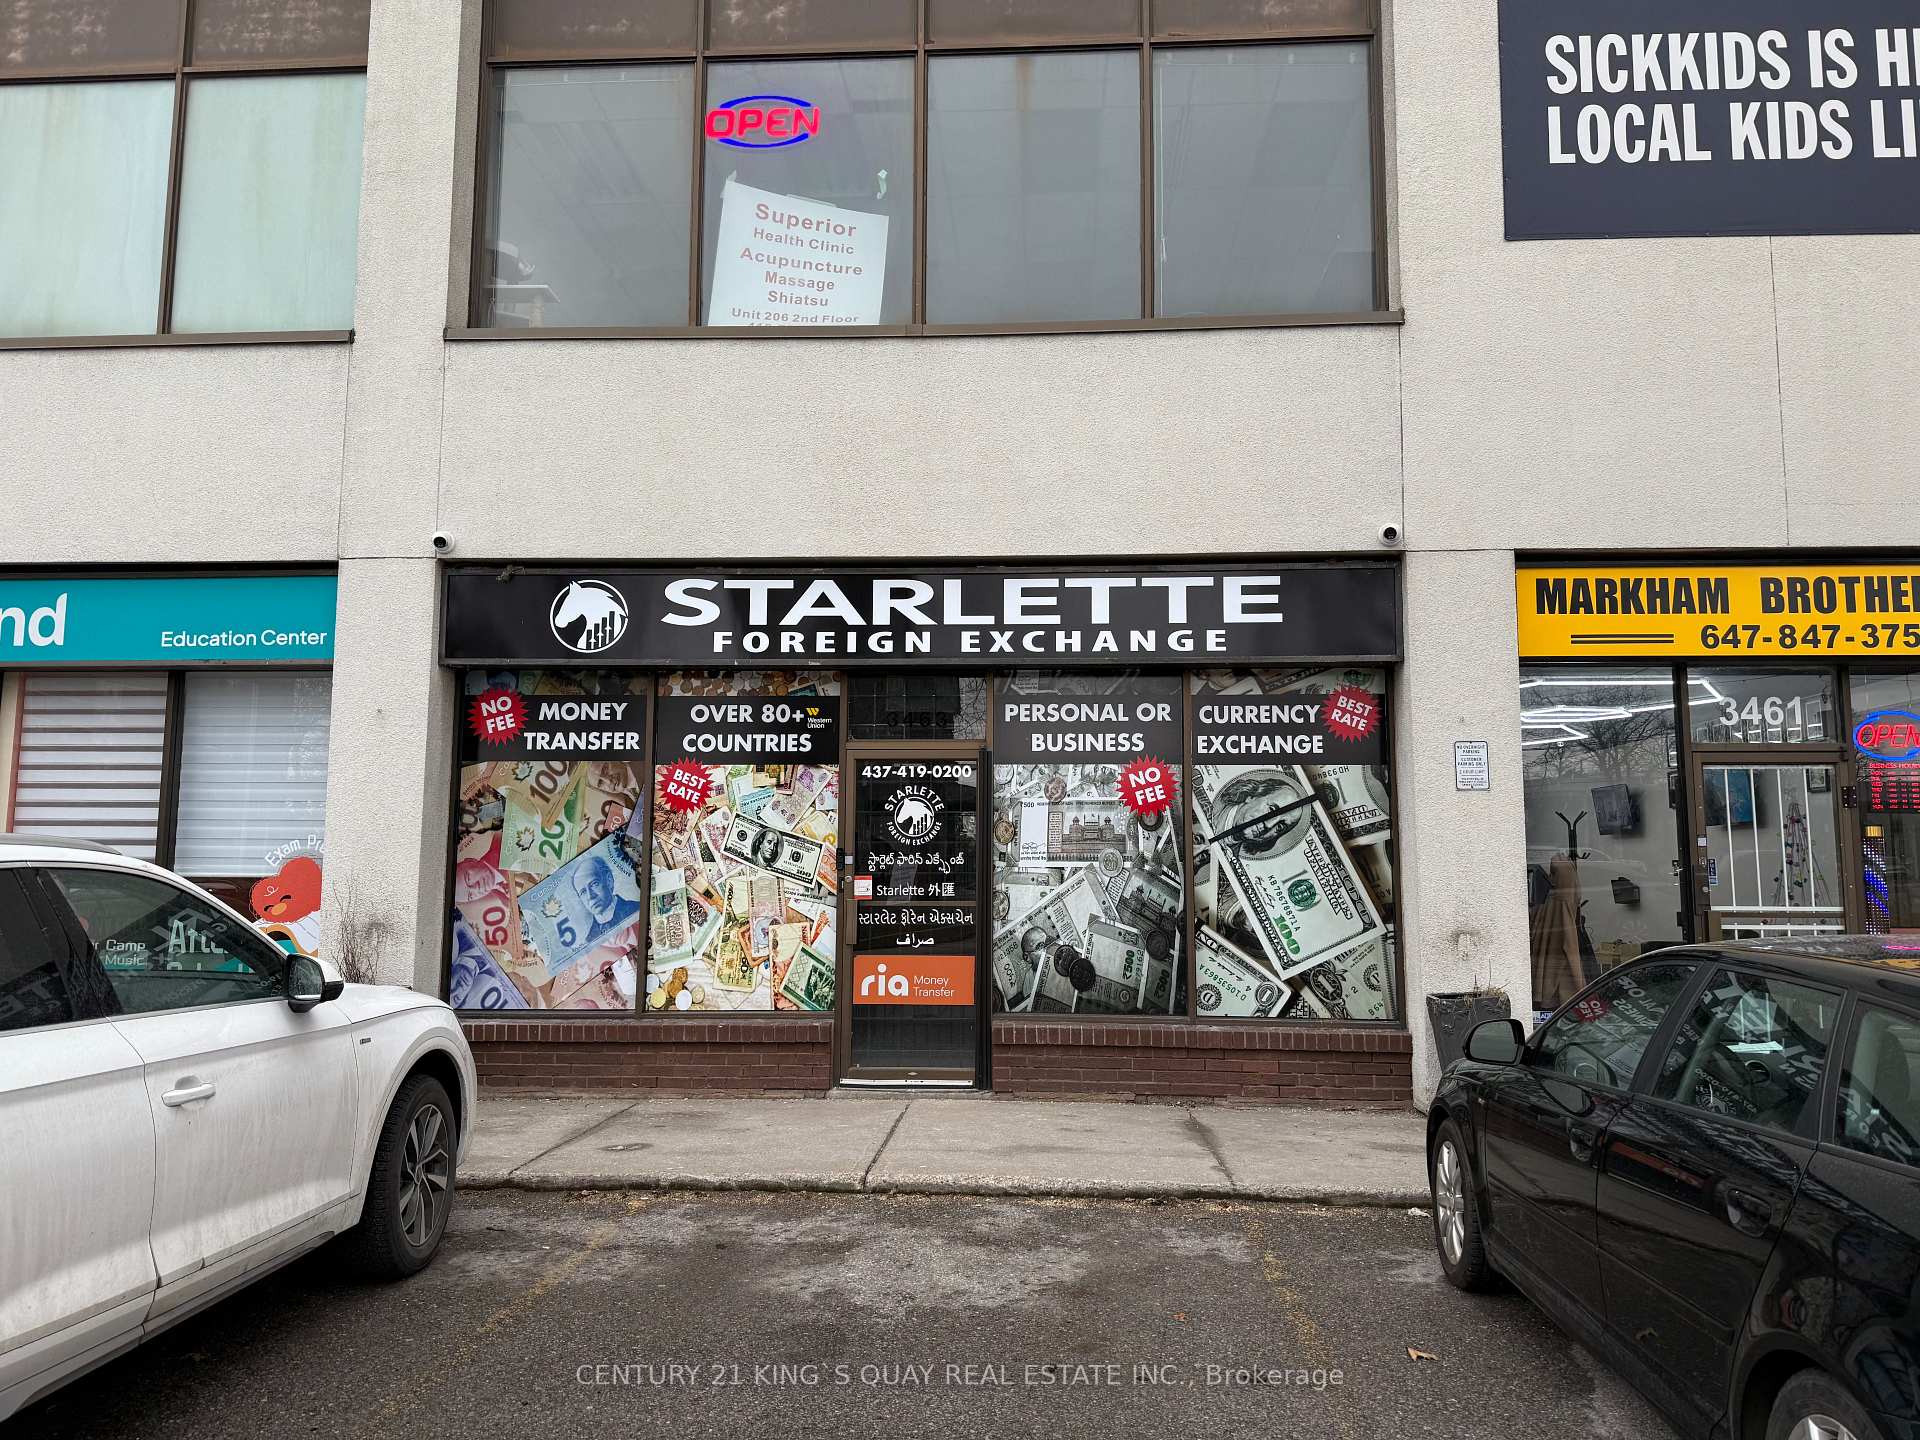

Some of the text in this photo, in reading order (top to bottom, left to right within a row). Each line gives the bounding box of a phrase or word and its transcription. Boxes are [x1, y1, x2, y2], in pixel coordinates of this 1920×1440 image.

[1545, 29, 1791, 94] SICKKIDS
[1807, 28, 1858, 88] IS
[705, 107, 821, 139] OPEN
[1547, 98, 1920, 164] LOCAL KIDS LI
[755, 203, 857, 237] Superior
[754, 228, 854, 255] Health Clinic
[740, 248, 863, 276] Acupuncture
[765, 270, 835, 292] Massage
[768, 290, 828, 307] Shiatsu
[732, 307, 859, 323] Unit 206 2nd Floor
[660, 575, 1283, 626] STARLETTE
[1535, 577, 1730, 615] MARKHAM
[161, 629, 327, 648] Education Center
[714, 629, 1226, 653] FOREIGN EXCHANGE
[1700, 623, 1920, 649] 647-847-375
[481, 696, 512, 717] NO
[539, 702, 628, 721] MONEY
[690, 704, 804, 723] OVER 80+
[1005, 703, 1171, 722] PERSONAL OR
[1199, 705, 1320, 723] CURRENCY
[1336, 695, 1372, 717] BEST
[1719, 696, 1801, 725] 3461
[486, 713, 516, 734] FEE
[1331, 709, 1367, 731] RATE
[524, 732, 640, 750] TRANSFER
[682, 733, 812, 752] COUNTRIES
[1031, 733, 1144, 752] BUSINESS
[1197, 735, 1323, 754] EXCHANGE
[529, 761, 569, 803] 100
[673, 769, 707, 790] BEST
[861, 765, 972, 778] 437-419-0200
[1128, 767, 1161, 788] NO
[667, 783, 701, 804] RATE
[884, 785, 945, 812] STARLETTE
[1134, 785, 1166, 806] FEE
[886, 821, 942, 846] FOREIGN EXCHANGE
[264, 839, 301, 867] Exam
[876, 884, 925, 896] Starlette
[483, 906, 509, 947] 50
[556, 916, 577, 948] 5
[1272, 913, 1303, 956] 100
[105, 939, 146, 952] Camp
[105, 953, 145, 966] Music
[860, 963, 909, 997] ria
[913, 975, 949, 986] Money
[913, 986, 955, 997] Transfer
